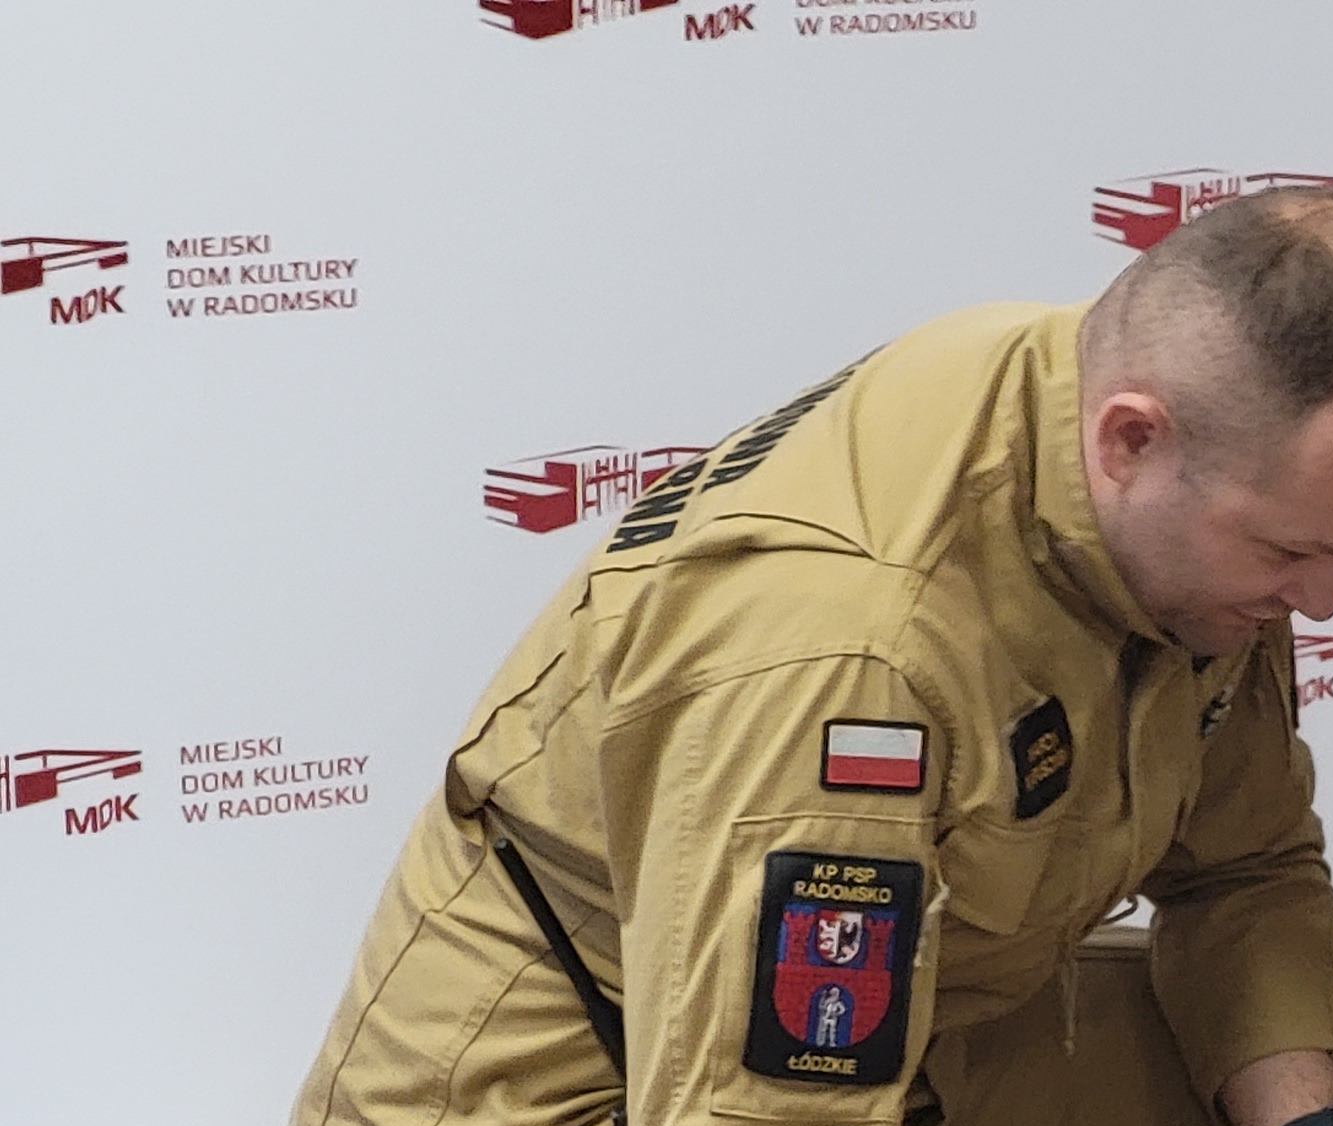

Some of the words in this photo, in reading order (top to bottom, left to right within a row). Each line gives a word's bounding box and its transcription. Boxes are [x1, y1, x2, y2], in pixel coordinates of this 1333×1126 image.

[684, 4, 755, 41] MDK
[795, 16, 822, 36] W
[829, 10, 977, 35] RADOMSKU
[166, 235, 271, 259] MIEJSKI
[167, 266, 231, 290] DOM
[240, 257, 359, 285] KULTURY
[49, 285, 127, 325] MDK
[167, 297, 194, 319] W
[204, 288, 358, 316] RADOMSKU
[180, 736, 283, 766] MIEJSKI
[181, 771, 243, 796] DOM
[252, 756, 370, 786] KULTURY
[65, 794, 139, 836] MDK
[181, 804, 207, 824] W
[217, 784, 369, 818] RADOMSKU
[813, 863, 838, 880] KP
[843, 866, 877, 884] PSP
[794, 881, 892, 904] RADOMSKO
[787, 1052, 858, 1075] ŁÓDZKIE
